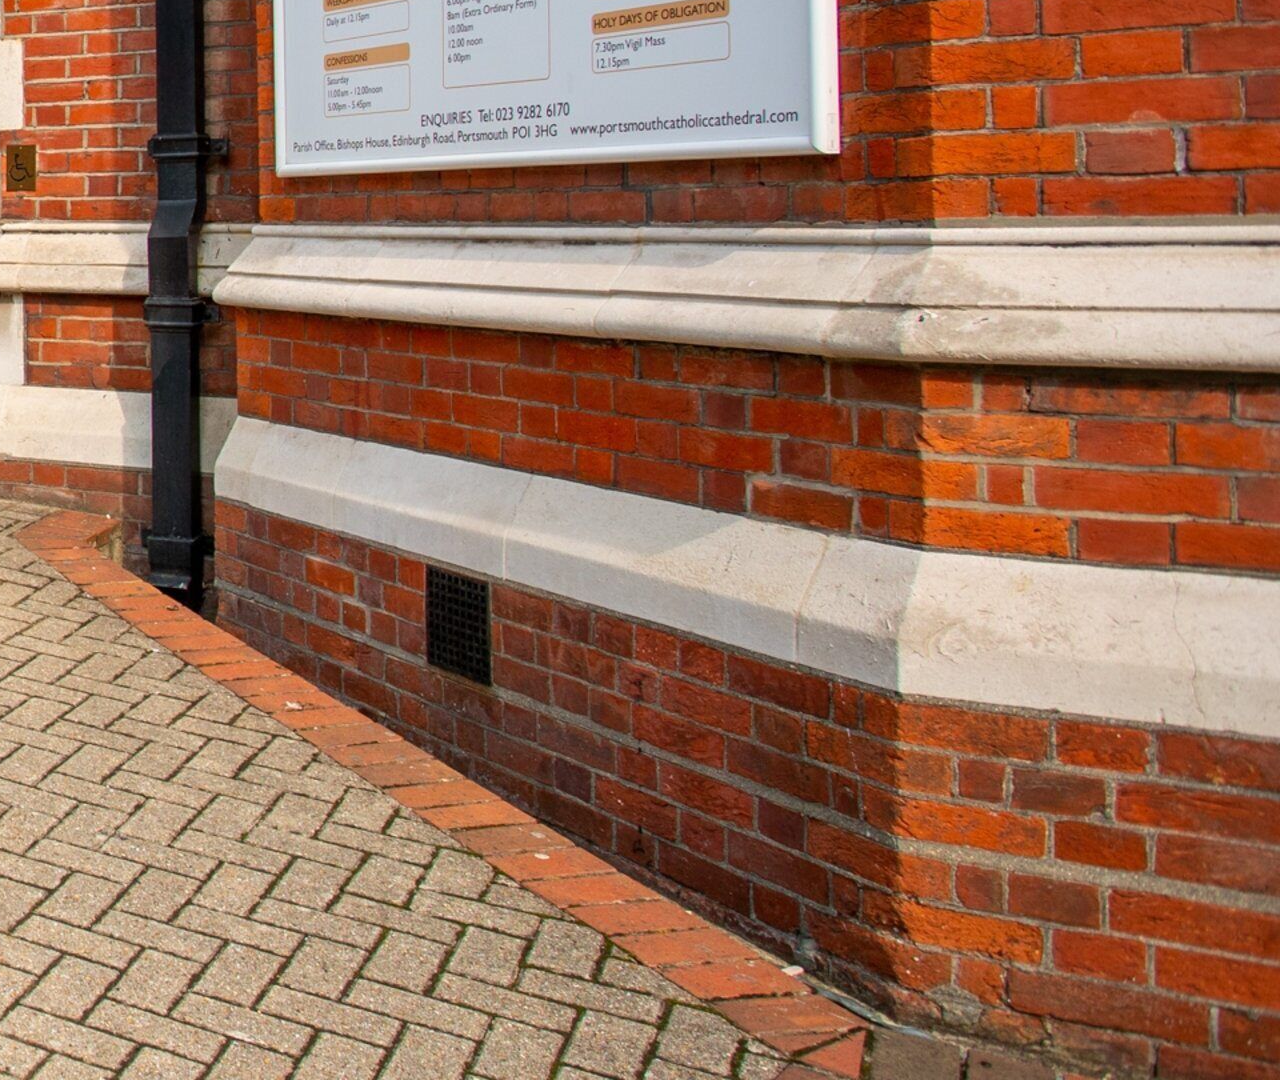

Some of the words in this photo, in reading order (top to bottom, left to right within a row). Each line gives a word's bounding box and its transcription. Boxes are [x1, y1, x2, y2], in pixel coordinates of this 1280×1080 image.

[447, 11, 460, 21] 8am
[462, 7, 482, 20] (Extra
[483, 3, 514, 15] Ordinary
[594, 17, 618, 29] HOLY
[619, 13, 642, 26] DAYS
[644, 10, 659, 23] OF
[661, 1, 726, 20] OBLIGATION
[326, 17, 339, 28] Daily
[466, 37, 483, 47] noon
[595, 41, 624, 54] 7.30pm
[624, 38, 642, 52] Vigil
[645, 36, 666, 48] Mass
[326, 52, 368, 67] CONFESSIONS
[596, 57, 630, 69] 12.15pm
[327, 76, 349, 86] Saturday
[421, 110, 472, 127] ENQUIRIES
[478, 108, 494, 123] Tel:
[495, 107, 514, 121] 023
[517, 104, 542, 120] 9282
[546, 102, 570, 117] 6170
[293, 142, 313, 153] Parish
[314, 139, 336, 152] Office,
[337, 138, 364, 152] Bishops
[365, 137, 391, 148] House,
[392, 134, 430, 148] Edinburgh
[433, 132, 456, 145] Road,
[457, 128, 508, 143] Portsmouth
[535, 124, 558, 138] 3HG
[570, 109, 799, 137] www.portsmouthcatholiccathedral.com
